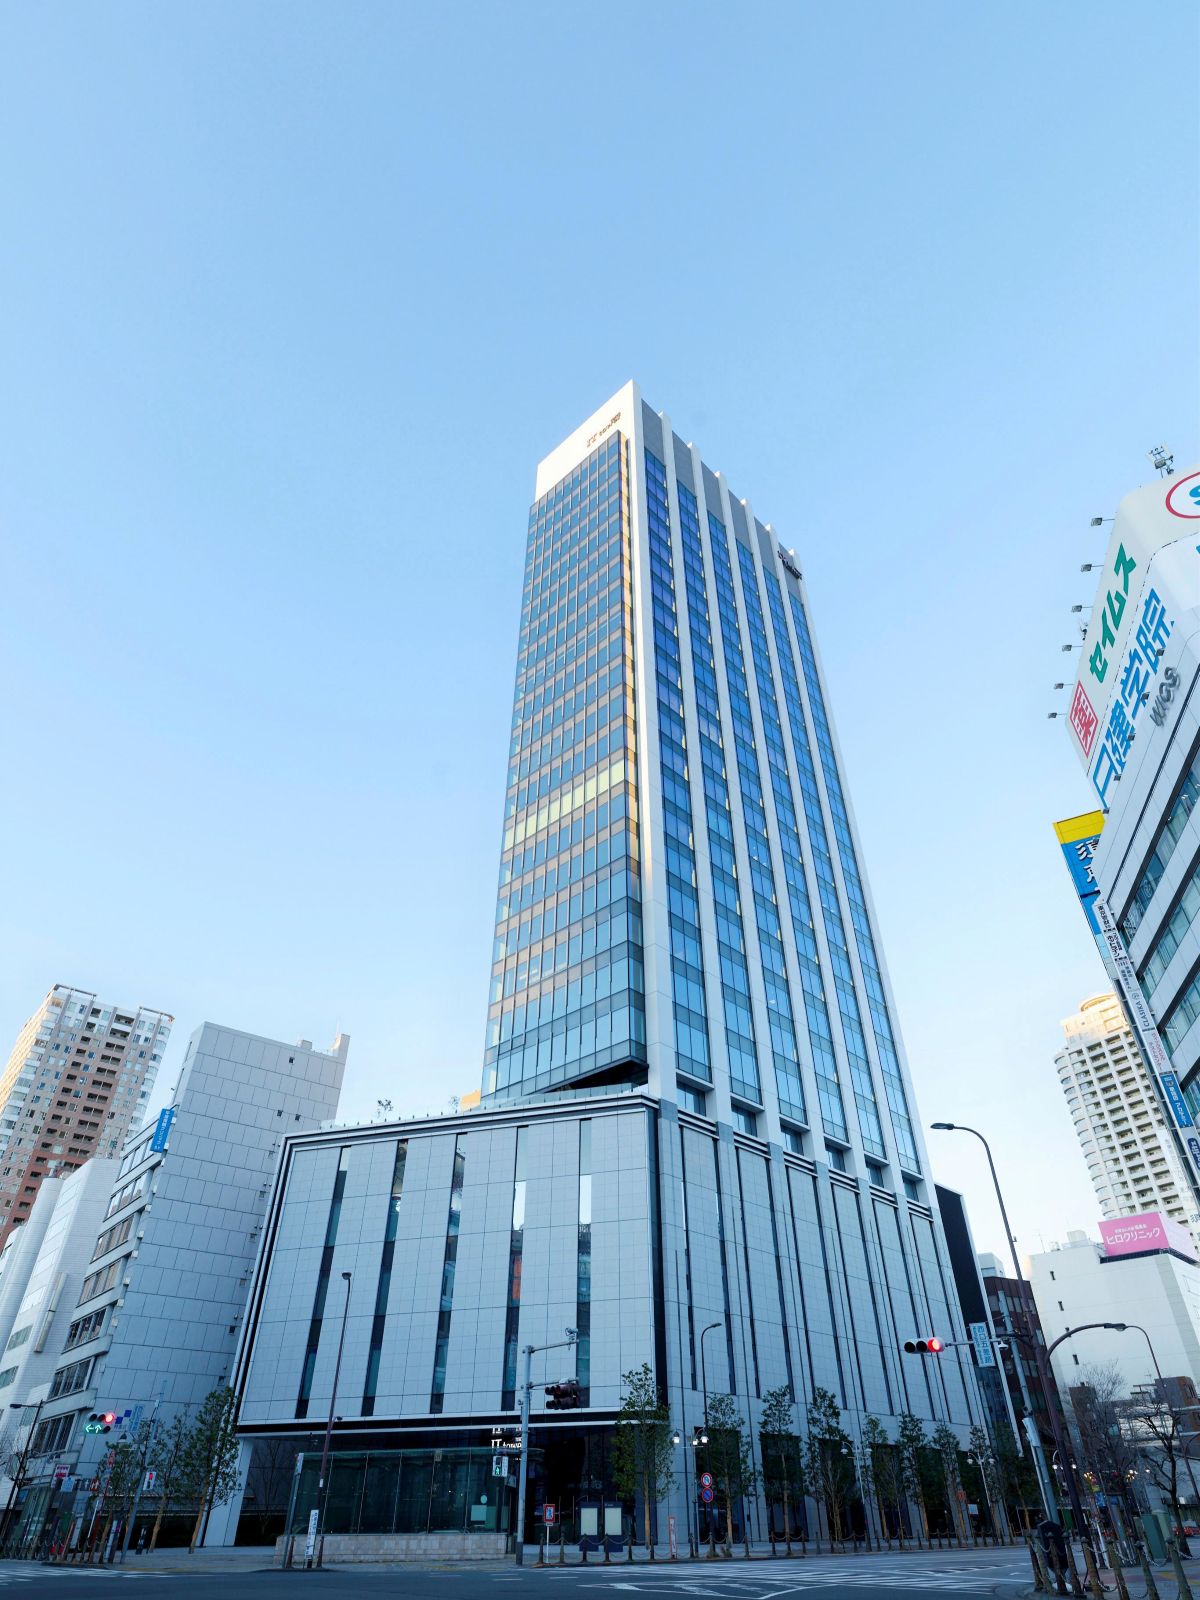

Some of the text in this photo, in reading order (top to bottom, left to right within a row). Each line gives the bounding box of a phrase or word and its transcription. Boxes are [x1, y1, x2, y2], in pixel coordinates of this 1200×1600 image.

[1089, 543, 1137, 683] セイムス
[1135, 1001, 1150, 1027] CLASIKA
[1106, 1227, 1160, 1245] ヒロクリニック
[491, 1439, 503, 1449] IT
